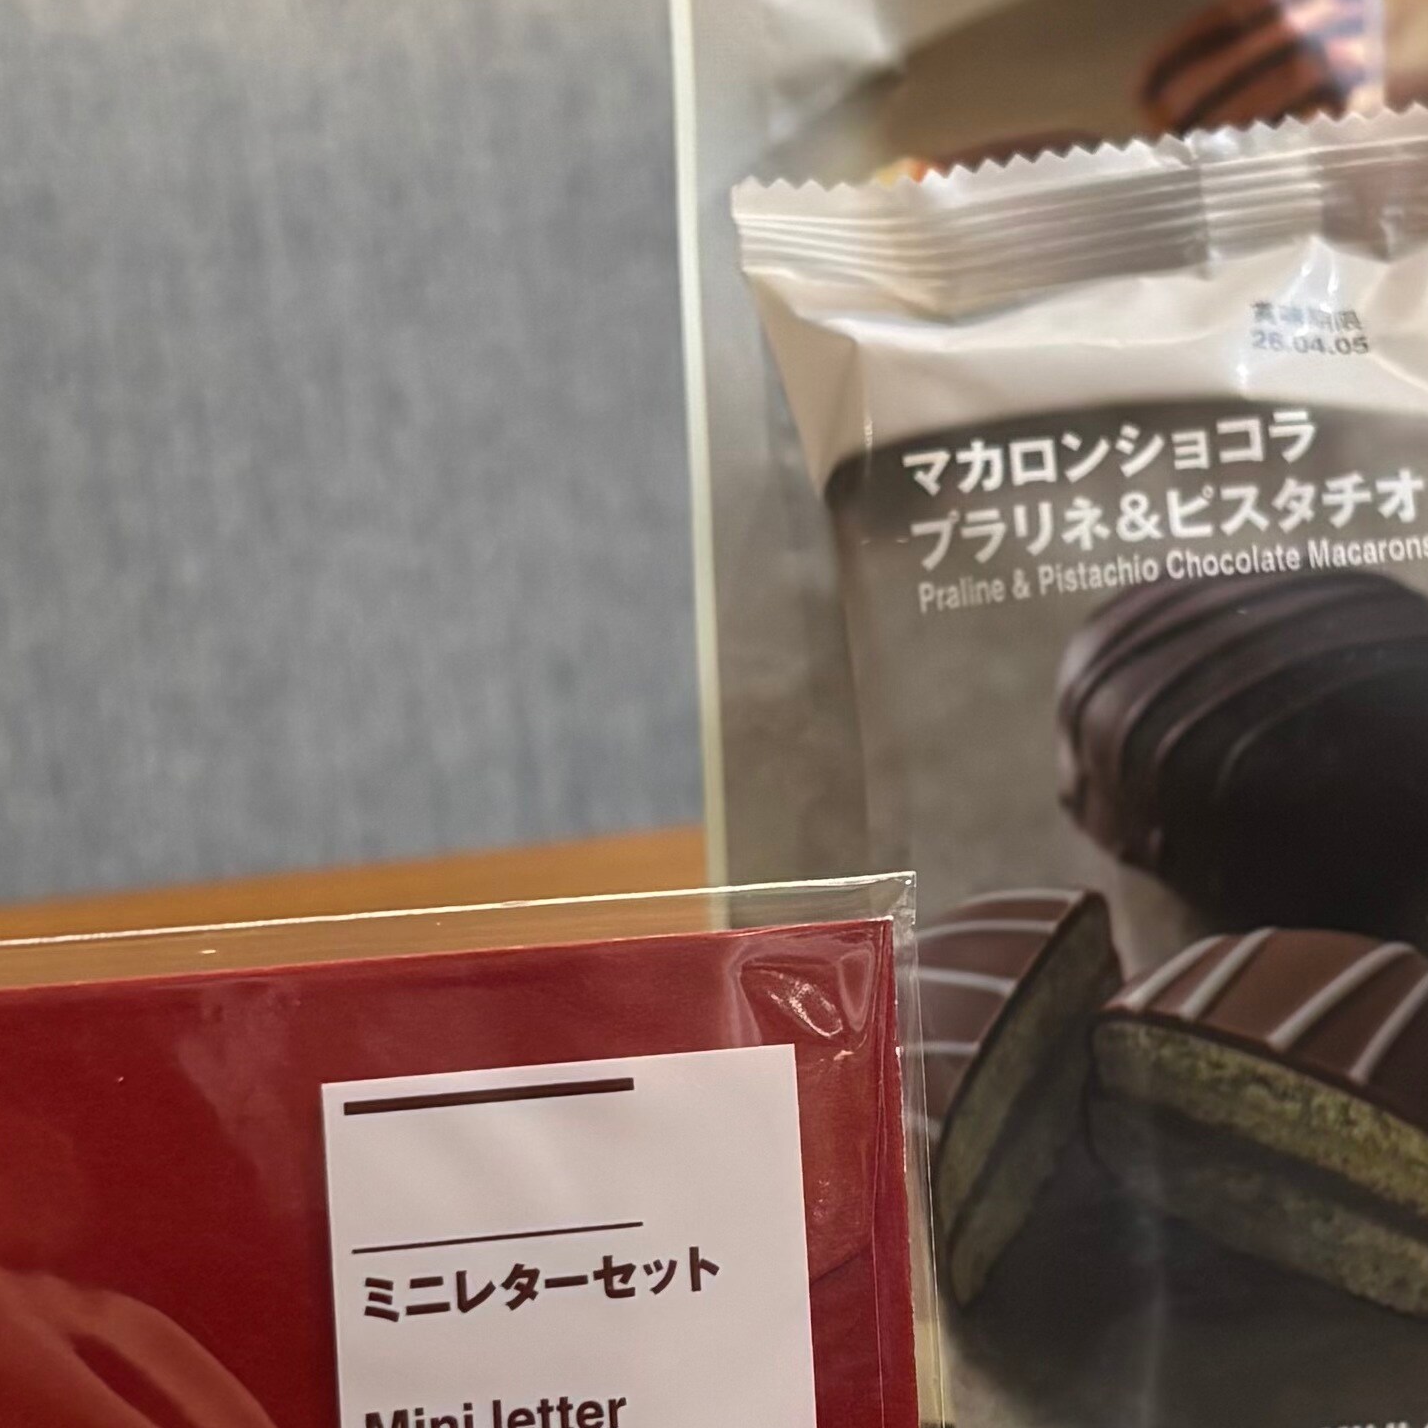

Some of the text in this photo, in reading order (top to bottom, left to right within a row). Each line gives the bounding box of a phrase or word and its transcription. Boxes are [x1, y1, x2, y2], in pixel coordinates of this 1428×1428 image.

[902, 410, 1315, 496] マカロンショコラ
[919, 573, 1006, 614] Praline
[1012, 569, 1031, 600] &
[1039, 551, 1158, 593] Pistachio
[1166, 538, 1300, 580] Chocolate
[364, 1246, 720, 1323] ミニレターセット
